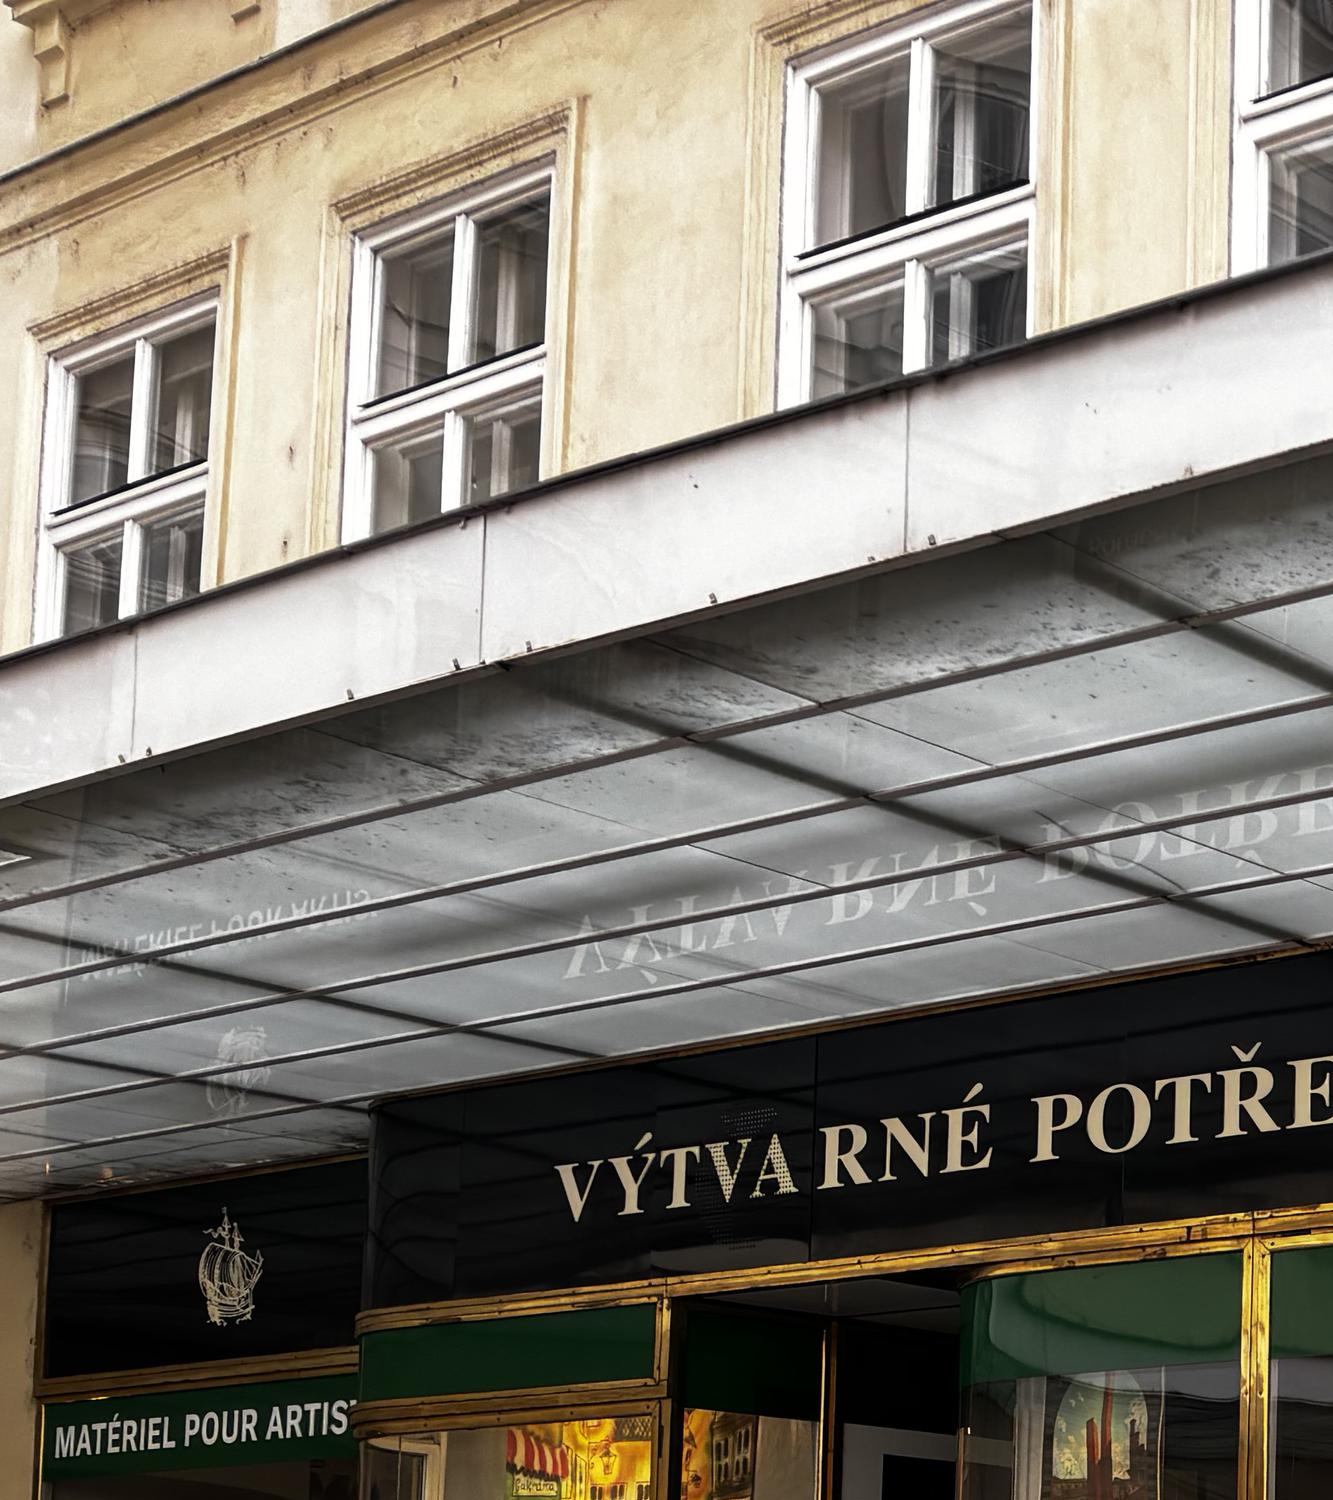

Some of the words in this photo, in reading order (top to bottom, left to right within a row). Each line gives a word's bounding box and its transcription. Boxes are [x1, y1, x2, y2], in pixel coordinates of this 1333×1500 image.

[54, 1413, 166, 1459] MATÉRIEL
[184, 1408, 258, 1447] POUR
[265, 1400, 357, 1441] ARTIS
